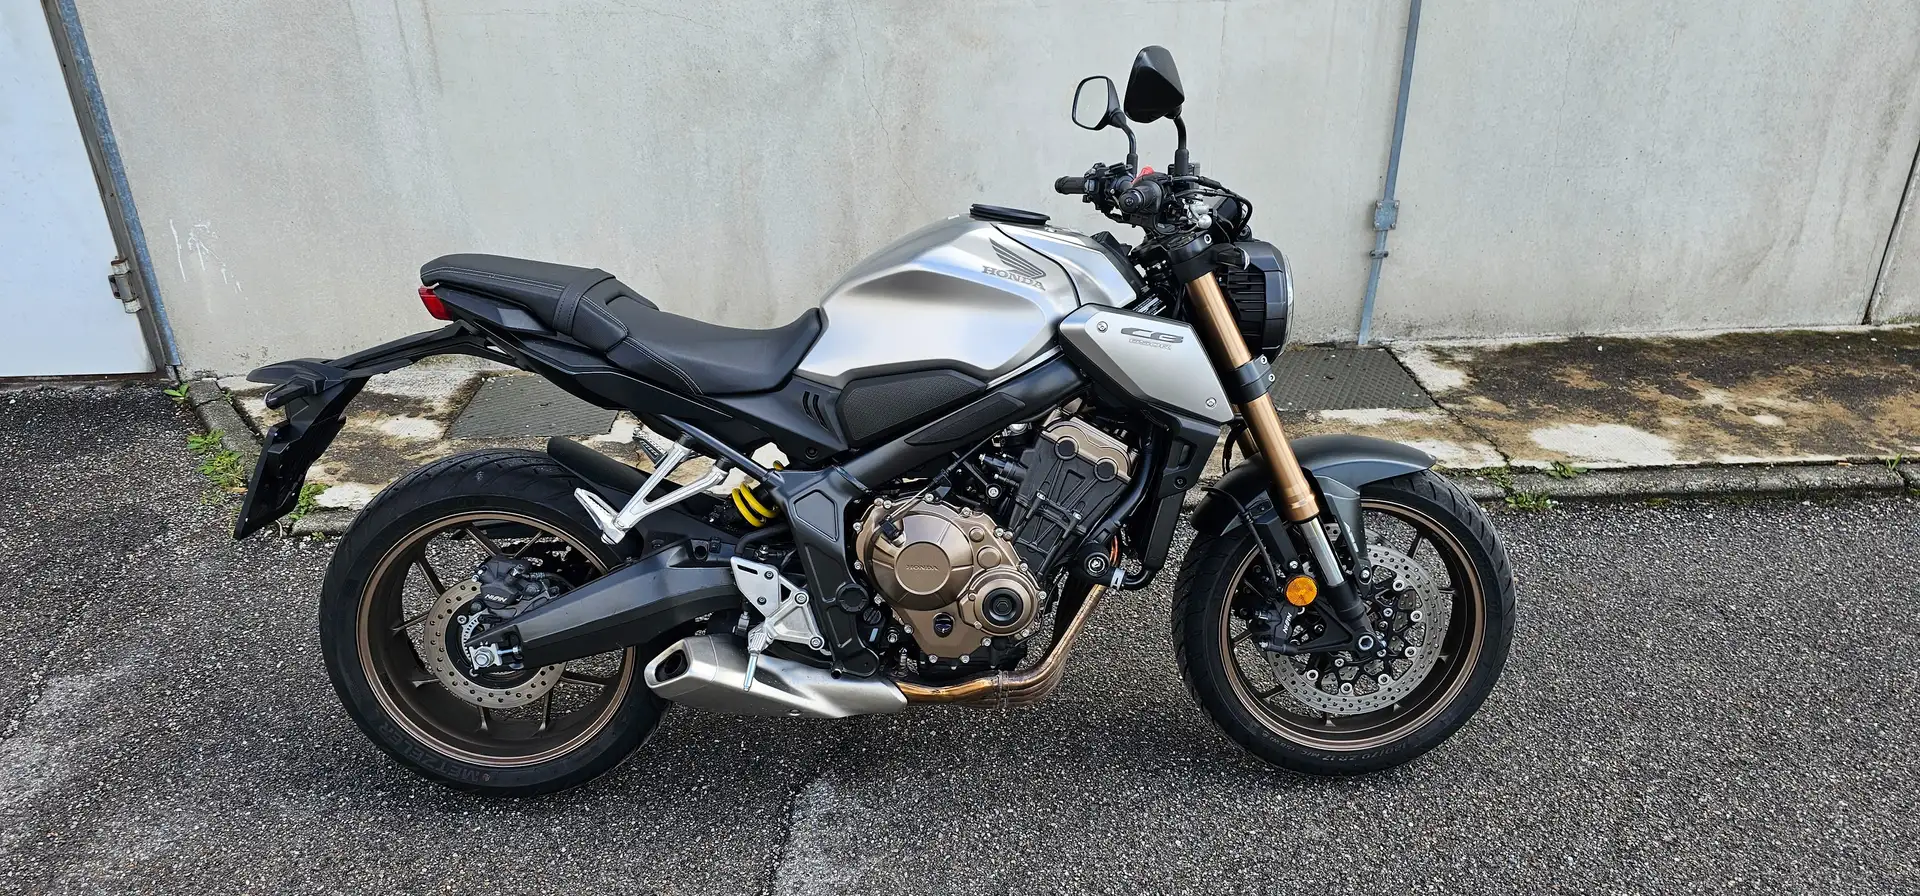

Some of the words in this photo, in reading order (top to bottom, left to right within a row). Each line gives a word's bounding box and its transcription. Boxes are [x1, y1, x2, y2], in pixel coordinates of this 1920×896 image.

[981, 265, 1046, 291] HONDA
[1120, 327, 1184, 344] CB
[379, 721, 480, 780] METZELER
